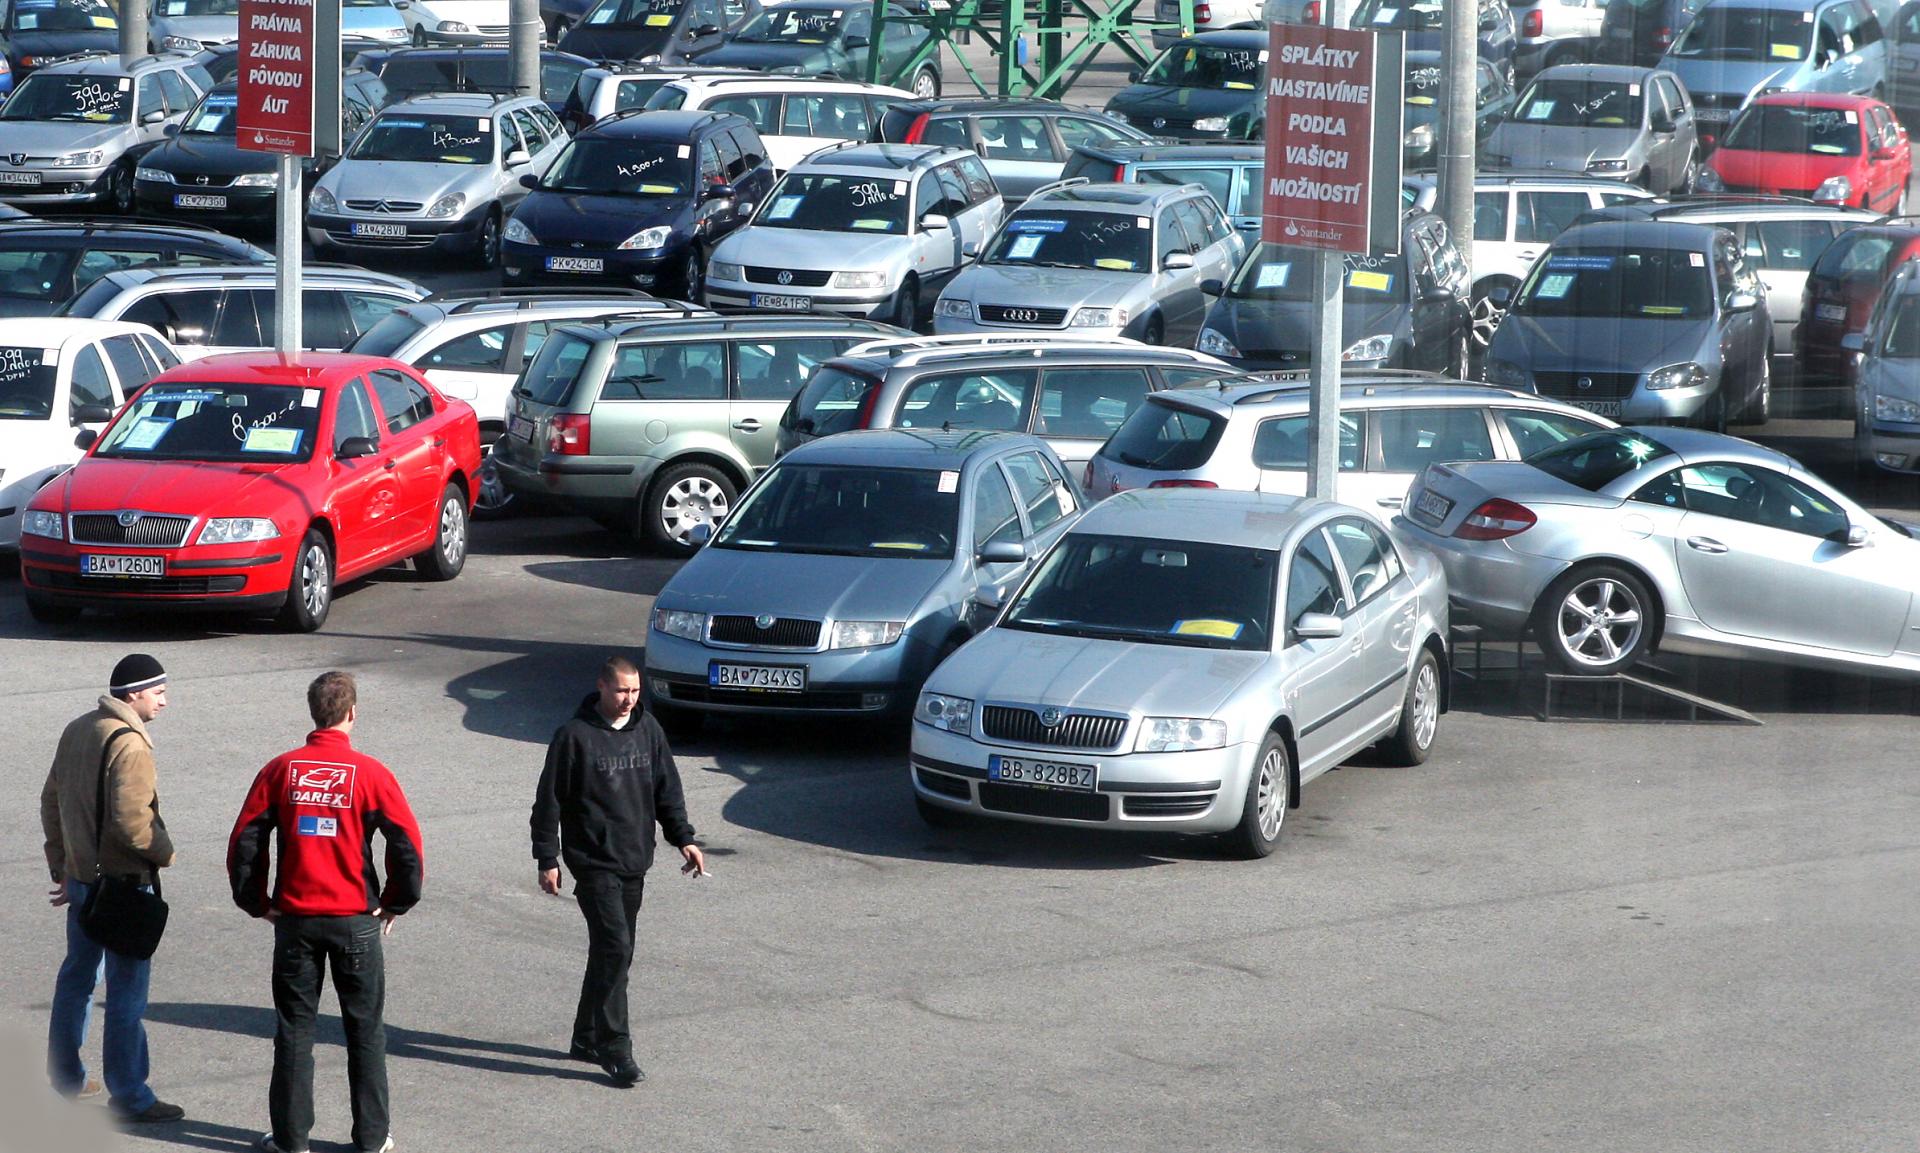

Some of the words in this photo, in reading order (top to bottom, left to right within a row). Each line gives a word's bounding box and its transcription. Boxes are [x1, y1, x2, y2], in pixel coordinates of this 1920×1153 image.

[251, 13, 302, 33] PRÁVNA
[250, 40, 301, 61] ZÁRUKA
[1281, 44, 1360, 69] SPLÁTKY
[249, 64, 302, 88] PÔVODU
[1269, 77, 1370, 104] NASTAVÍME
[261, 95, 289, 114] ÁUT
[1288, 113, 1347, 136] PODĽA
[264, 134, 296, 147] Santander
[1286, 144, 1349, 169] VAŠICH
[1269, 177, 1363, 205] MOŽNOSTÍ
[1300, 225, 1343, 240] Santander
[1001, 760, 1092, 787] BB-828BZ
[292, 791, 344, 807] DAREX
